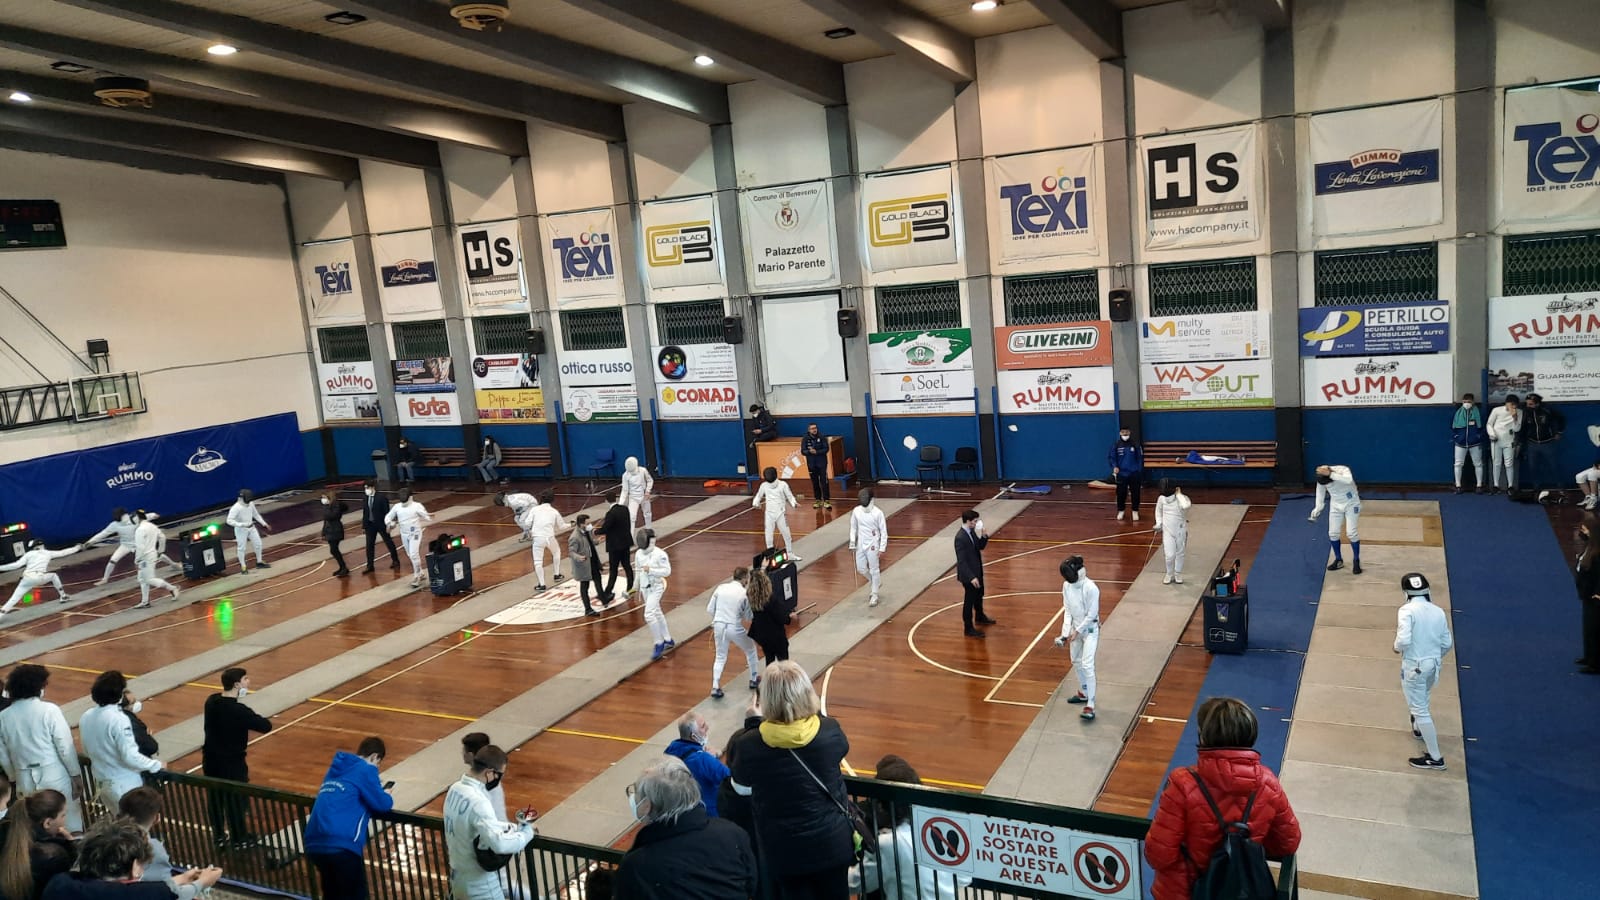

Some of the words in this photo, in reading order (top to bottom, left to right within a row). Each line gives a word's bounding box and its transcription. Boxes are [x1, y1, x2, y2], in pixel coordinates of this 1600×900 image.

[1353, 152, 1398, 166] RUMMO
[1151, 150, 1240, 202] HS
[753, 194, 778, 202] Comune
[785, 188, 818, 198] Benevento
[1000, 176, 1089, 236] Texi
[881, 212, 908, 222] GOLD
[909, 208, 942, 219] BLACK
[1150, 220, 1249, 237] www.hscompany.it
[656, 237, 679, 245] GOLD
[679, 233, 707, 243] BLACK
[465, 237, 514, 271] HS
[552, 233, 614, 279] Texi
[765, 244, 815, 257] Palazzetto
[757, 262, 786, 273] Mario
[788, 258, 826, 270] Parente
[315, 262, 352, 294] Texi
[1367, 307, 1445, 324] PETRILLO
[1177, 318, 1204, 331] multy
[1177, 328, 1211, 337] service
[1025, 331, 1093, 348] LIVERINI
[561, 361, 597, 375] ottica
[599, 362, 633, 374] russo
[1154, 364, 1225, 383] WAY
[326, 374, 373, 391] RUMMO
[917, 374, 950, 390] SoeL
[1321, 376, 1436, 401] RUMMO
[676, 387, 736, 403] CONAD
[1012, 385, 1101, 409] RUMMO
[408, 395, 450, 417] festa
[720, 405, 738, 413] LEVA
[106, 471, 154, 489] RUMMO
[984, 821, 1055, 844] VIETATO
[983, 836, 1058, 859] SOSTARE
[976, 849, 994, 863] IN
[999, 853, 1069, 876] QUESTA
[1000, 867, 1047, 886] AREA
